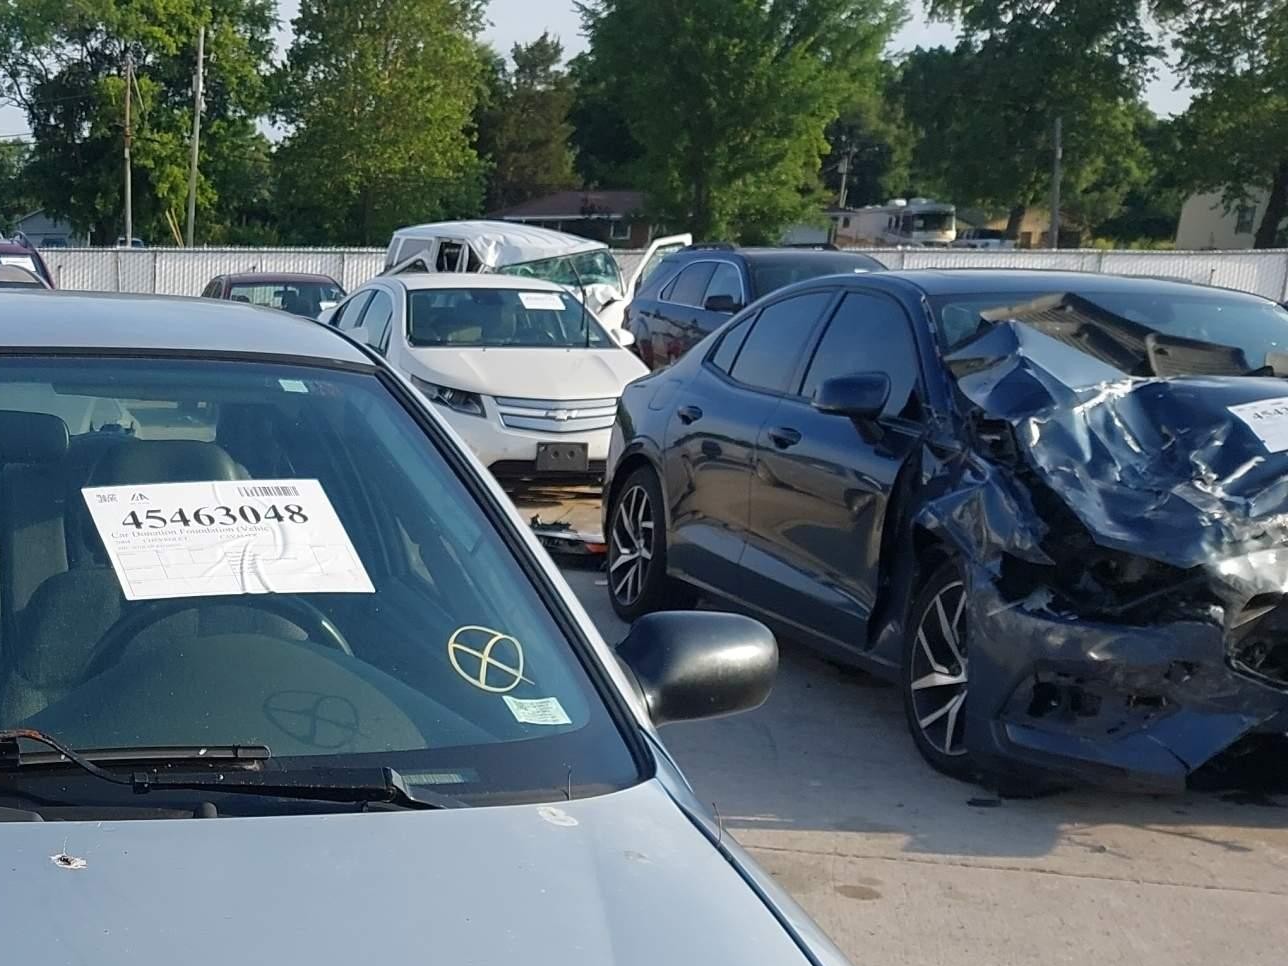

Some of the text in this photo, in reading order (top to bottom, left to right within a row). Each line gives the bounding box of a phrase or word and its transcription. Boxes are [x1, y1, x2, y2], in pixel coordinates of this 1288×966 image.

[122, 504, 309, 529] 45463048
[132, 529, 177, 538] Donation
[179, 526, 234, 535] Foundation
